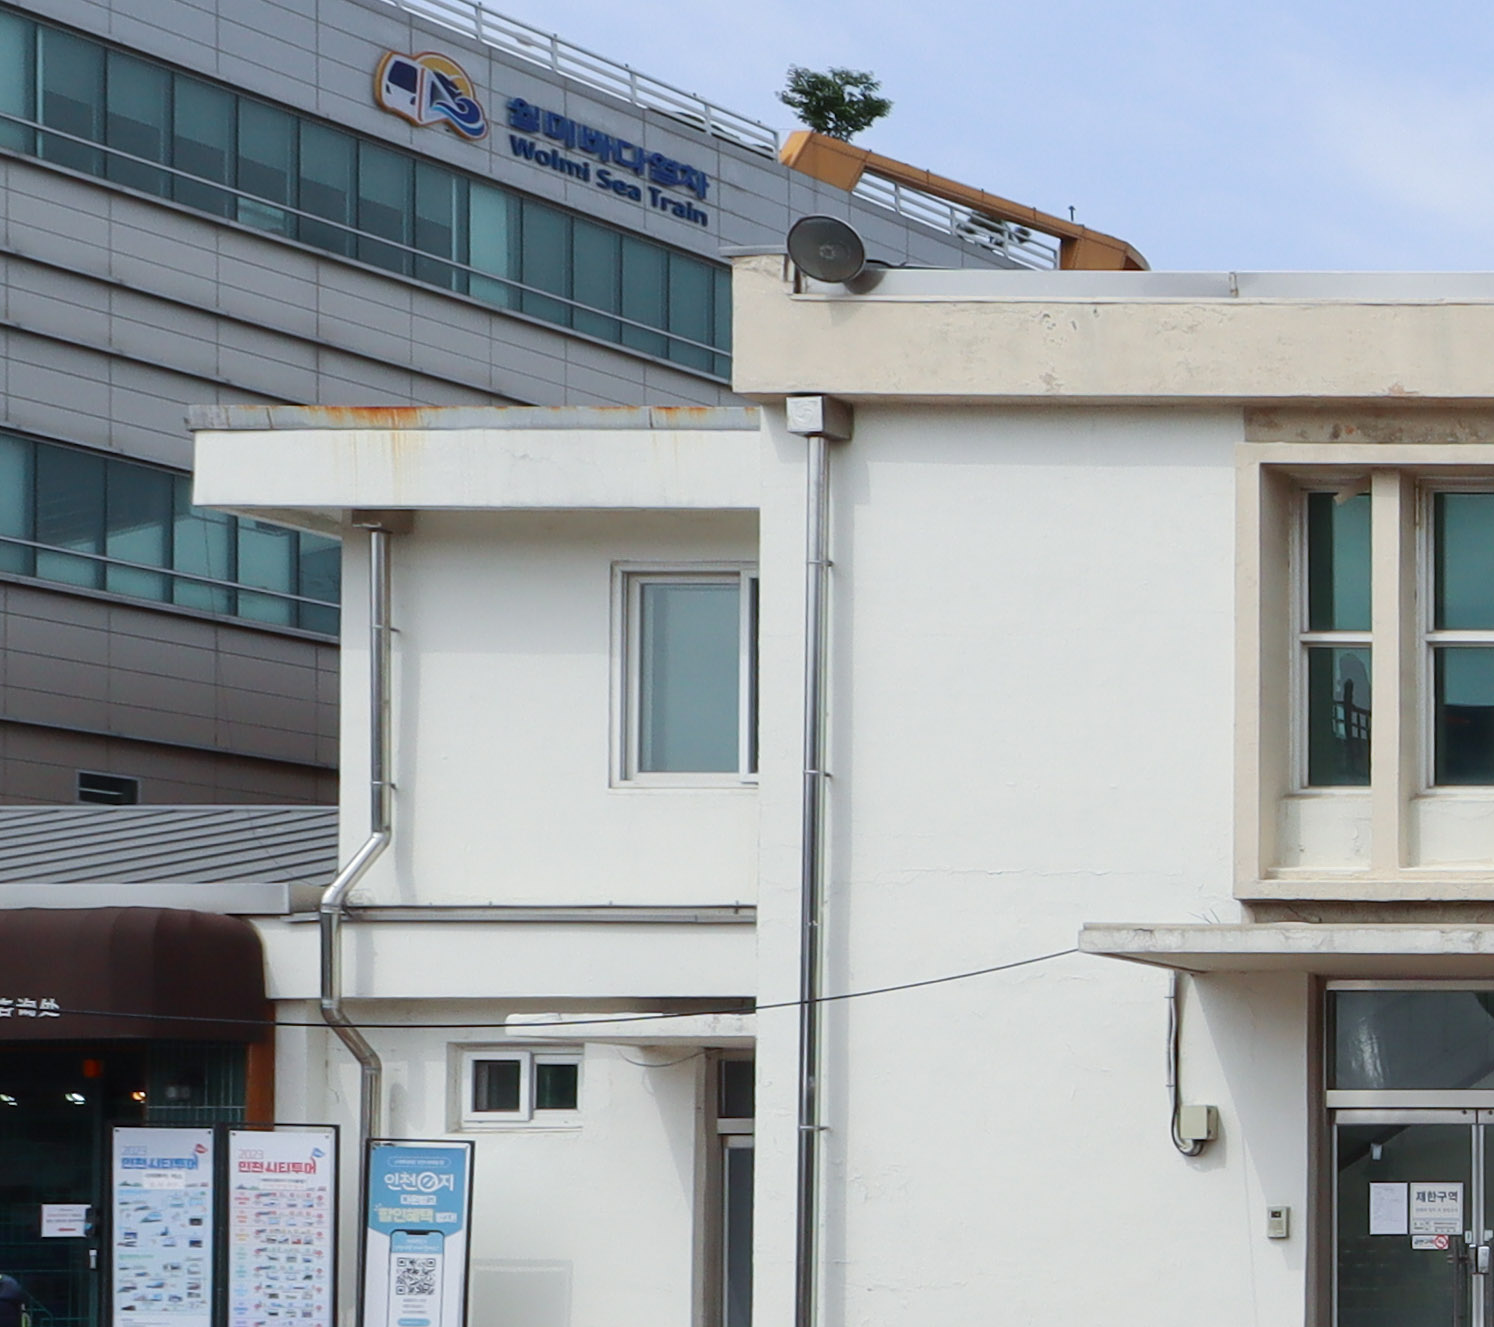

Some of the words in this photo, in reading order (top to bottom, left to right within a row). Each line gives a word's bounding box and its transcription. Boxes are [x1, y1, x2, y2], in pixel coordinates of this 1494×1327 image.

[507, 97, 709, 199] 월미바다열차
[508, 134, 591, 183] Wolmi
[596, 168, 642, 202] Sea
[647, 185, 708, 227] Train
[1415, 1190, 1459, 1204] 제한구역
